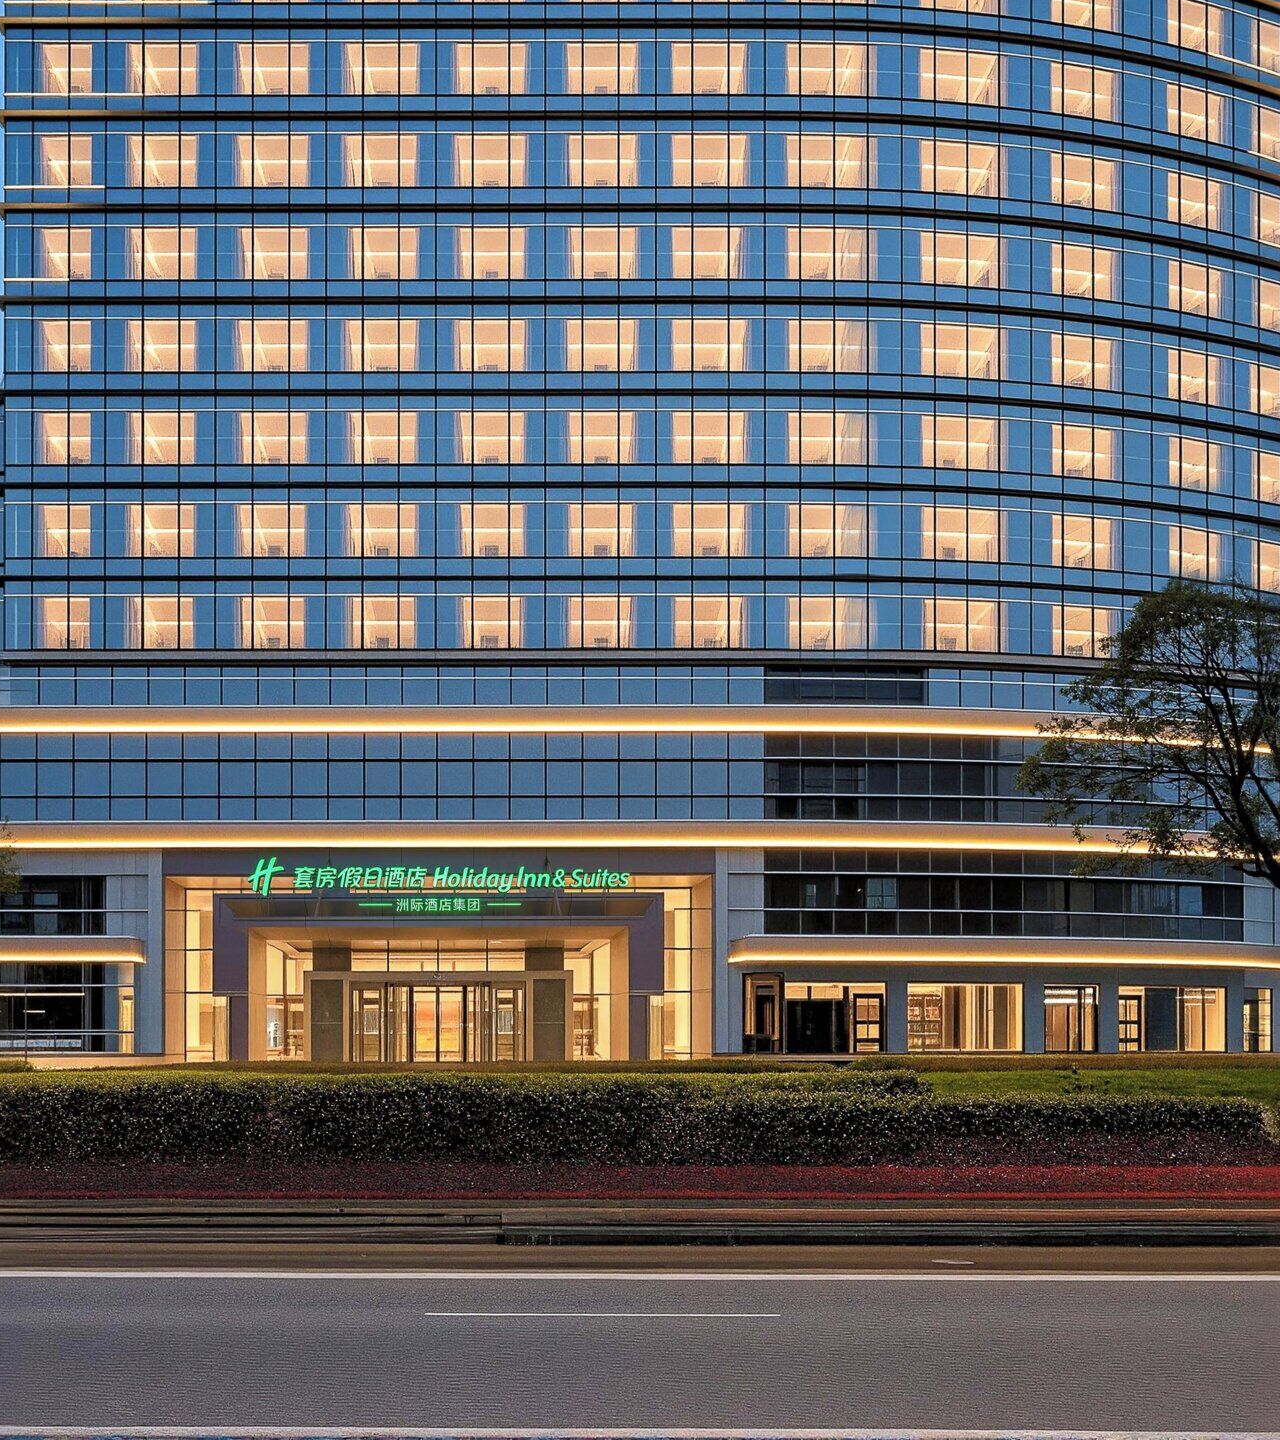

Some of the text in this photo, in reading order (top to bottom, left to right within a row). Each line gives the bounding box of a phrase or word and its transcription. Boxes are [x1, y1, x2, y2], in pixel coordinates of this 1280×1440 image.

[292, 866, 428, 888] 套房假日酒店
[433, 866, 515, 892] Holiday
[516, 866, 551, 887] Inn
[552, 869, 566, 887] &
[570, 868, 630, 887] Suites
[396, 898, 480, 912] 洲际酒店集团
